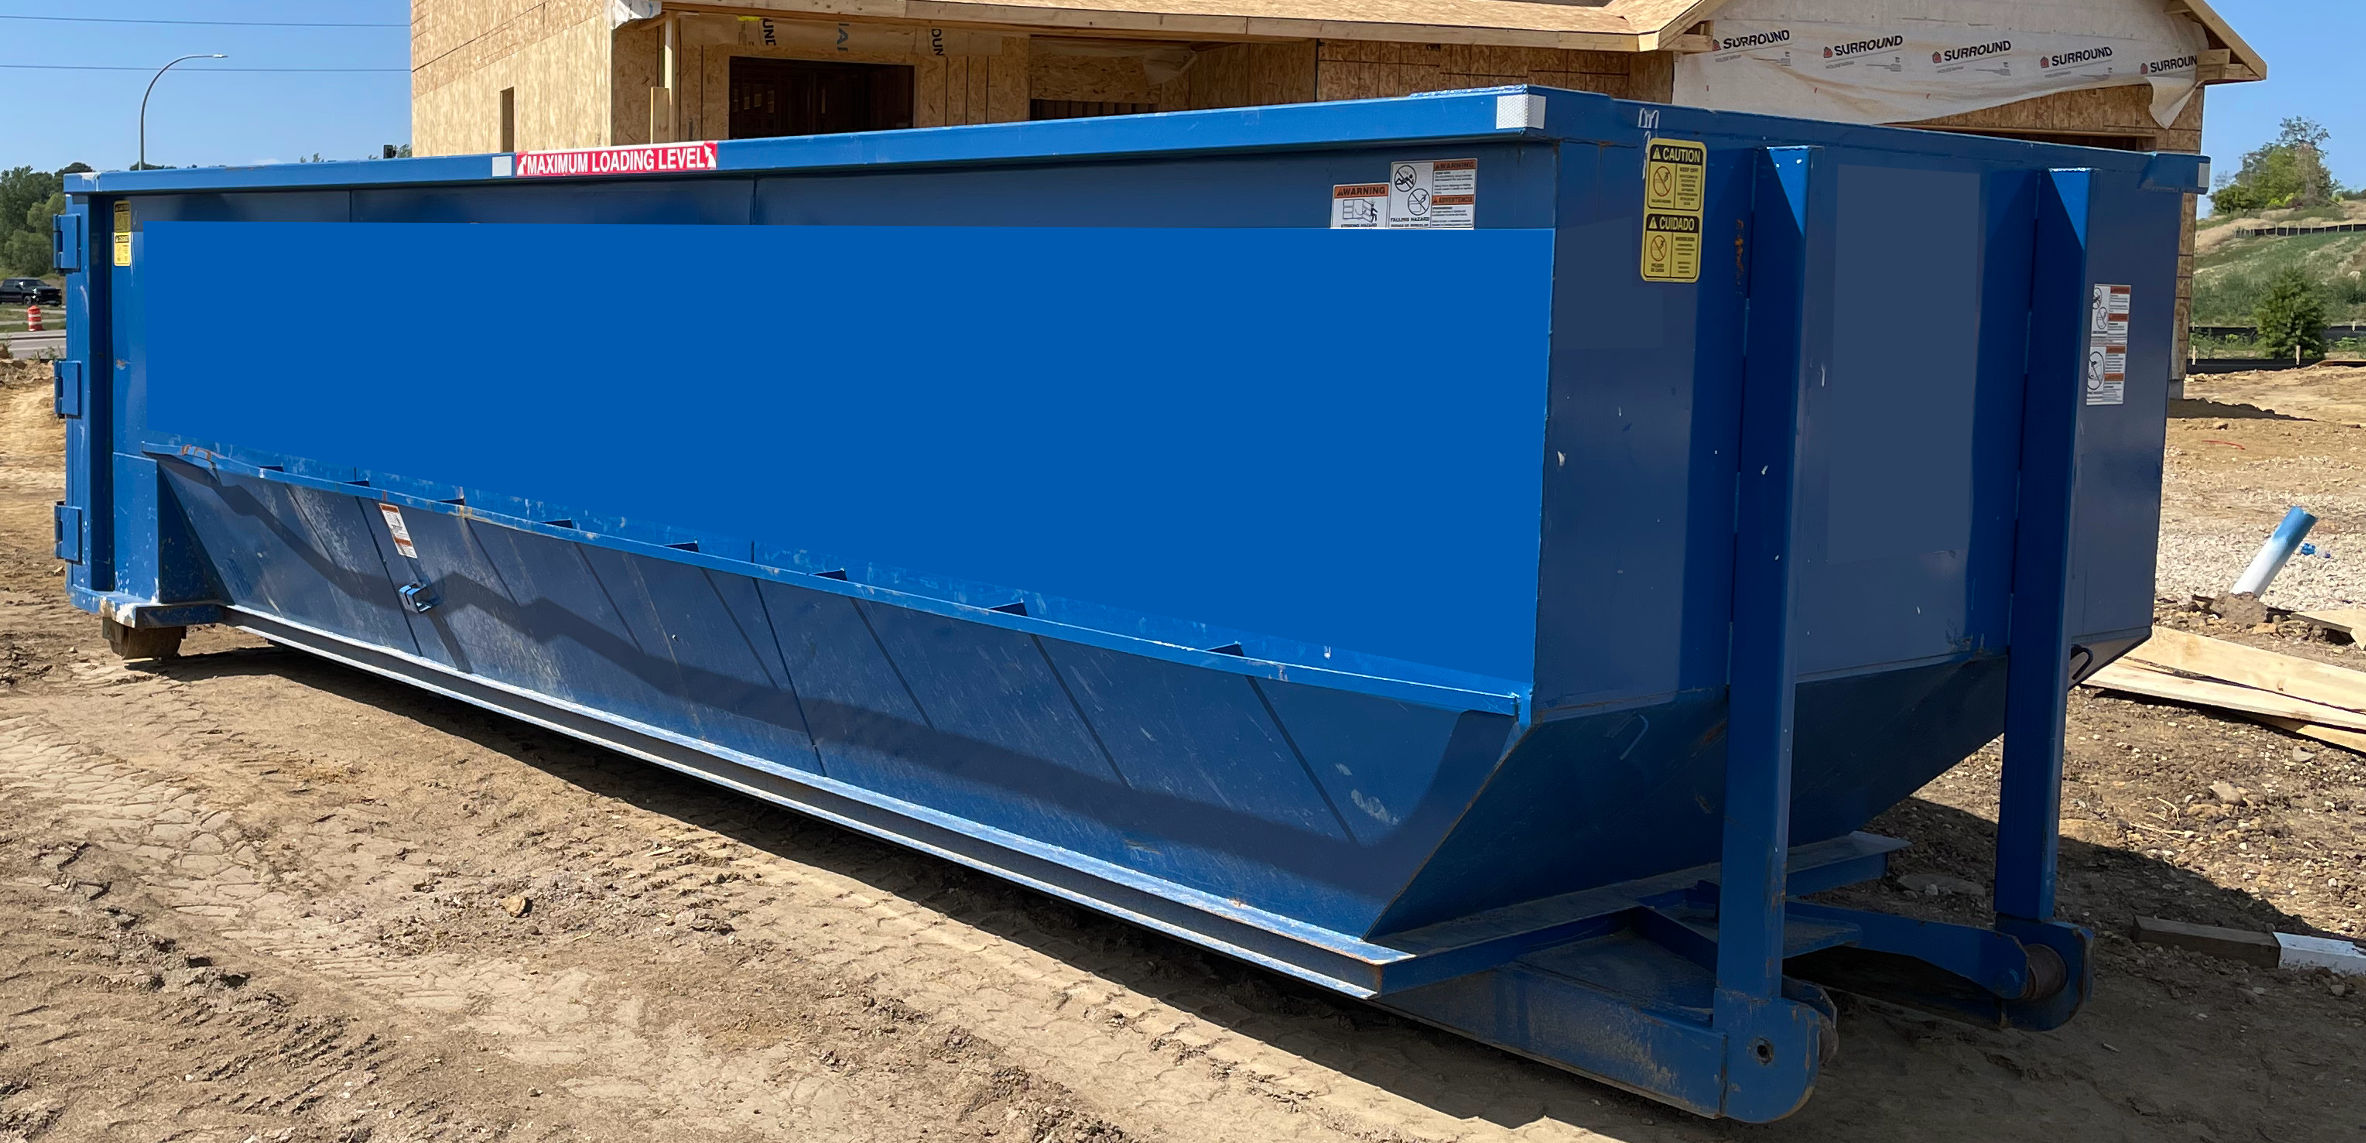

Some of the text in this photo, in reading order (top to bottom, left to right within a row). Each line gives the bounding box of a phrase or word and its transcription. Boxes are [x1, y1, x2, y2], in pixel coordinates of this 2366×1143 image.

[1723, 29, 1790, 49] SURROUND
[1834, 35, 1903, 56] SURROUND
[1944, 40, 2012, 61] SURROUND
[2051, 46, 2113, 66] SURROUND
[2150, 55, 2198, 73] SURROUN
[527, 147, 705, 175] MAXIMUM LOADING LEVEL
[1662, 147, 1701, 162] CAUTION
[1343, 186, 1386, 196] WARNING
[1659, 216, 1695, 231] CUIDADO
